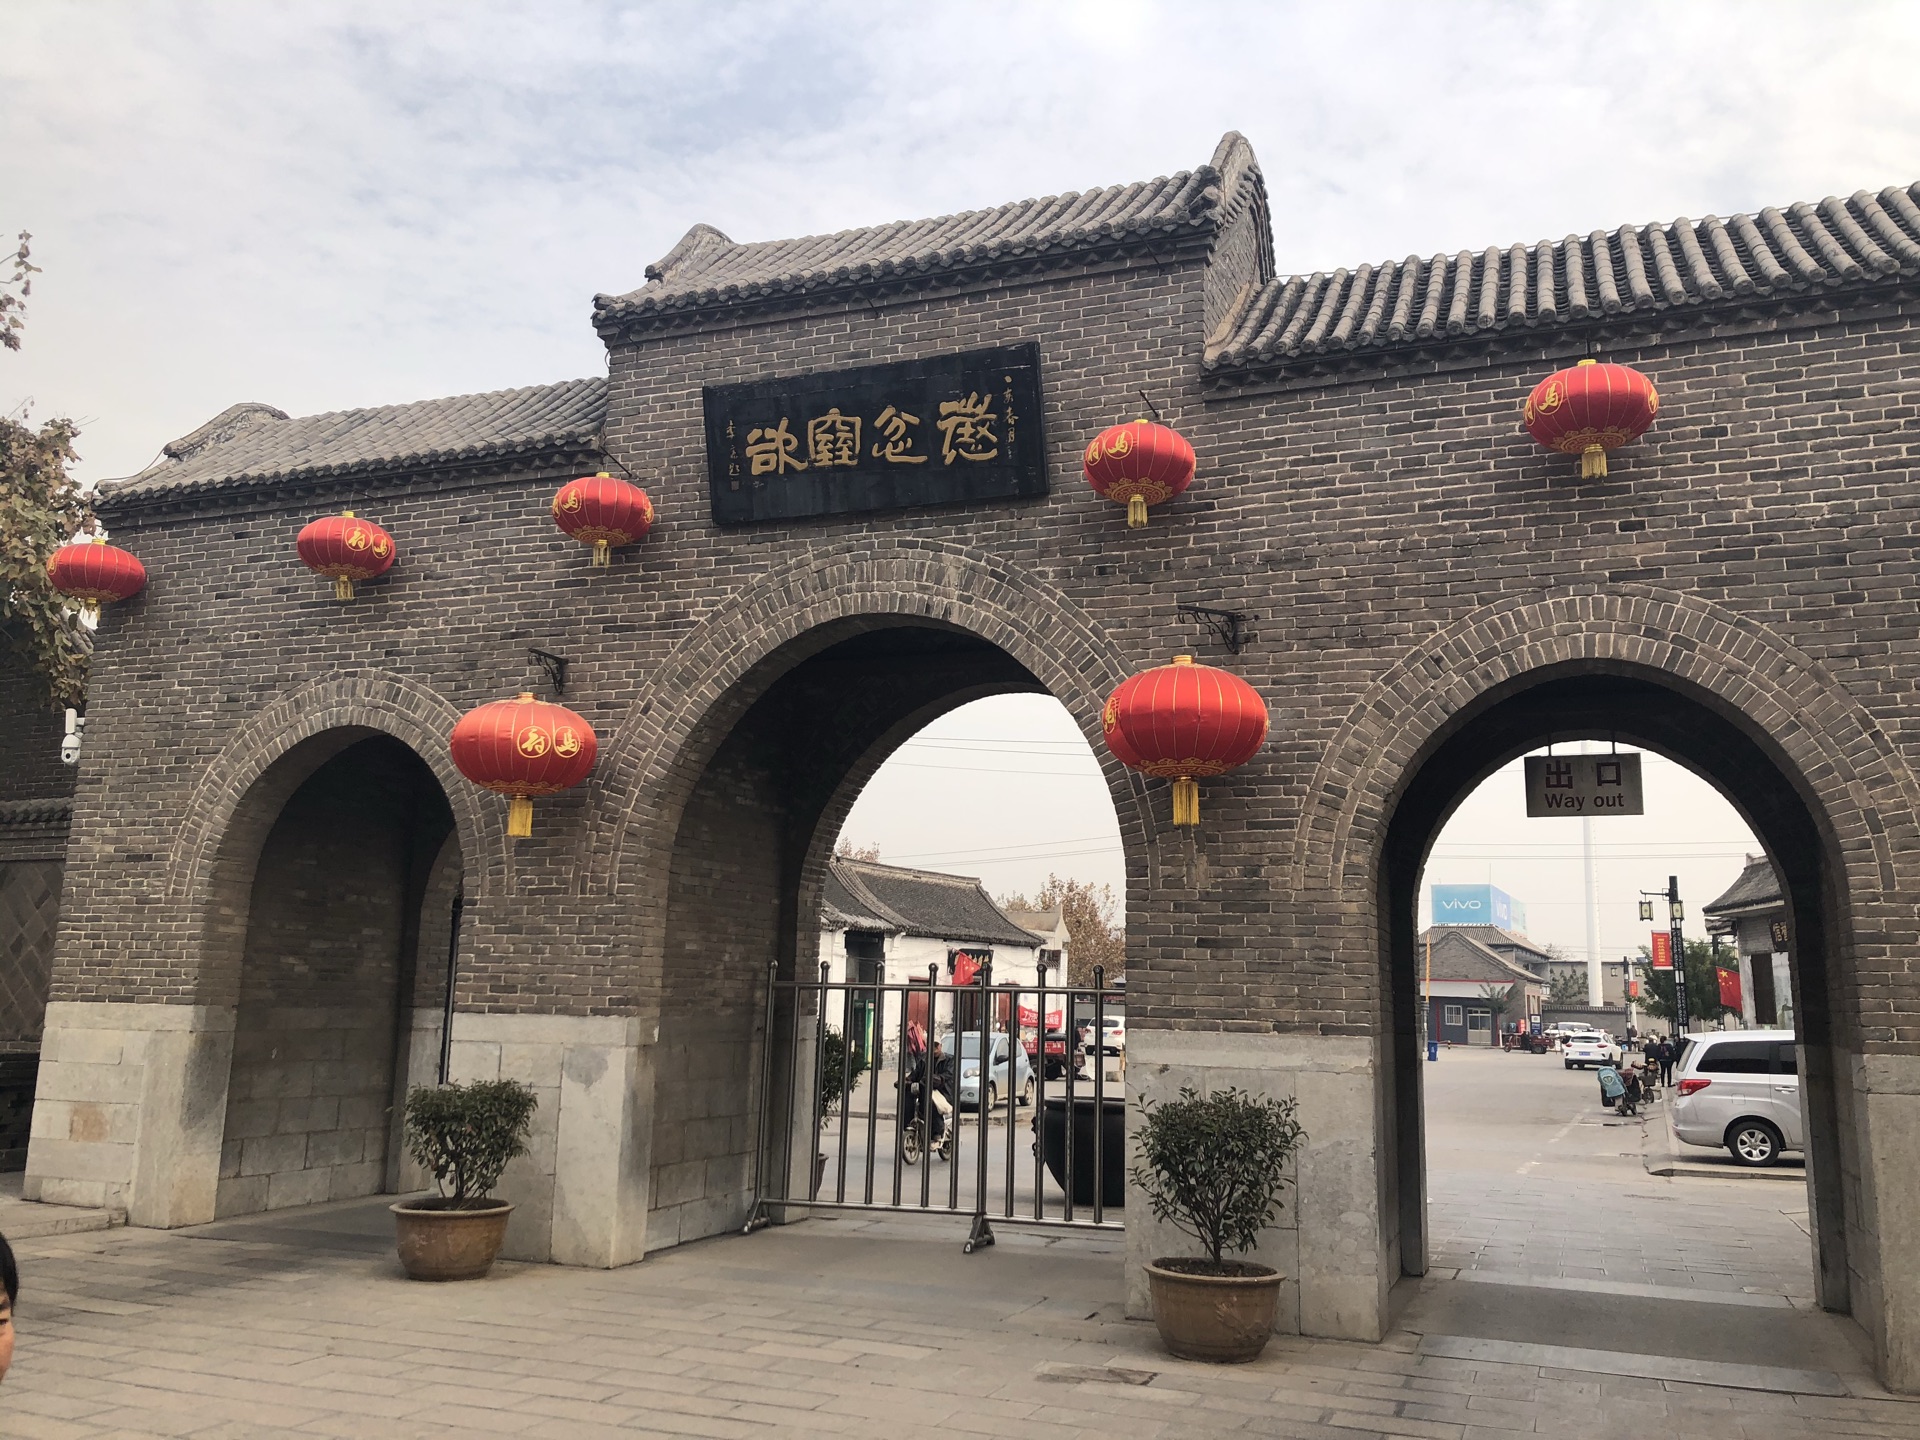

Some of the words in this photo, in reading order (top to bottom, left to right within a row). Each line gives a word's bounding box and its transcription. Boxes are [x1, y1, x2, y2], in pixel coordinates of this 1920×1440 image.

[1545, 760, 1622, 789] 出口
[1544, 793, 1585, 811] Way
[1593, 792, 1625, 807] out
[1442, 897, 1482, 909] vivo
